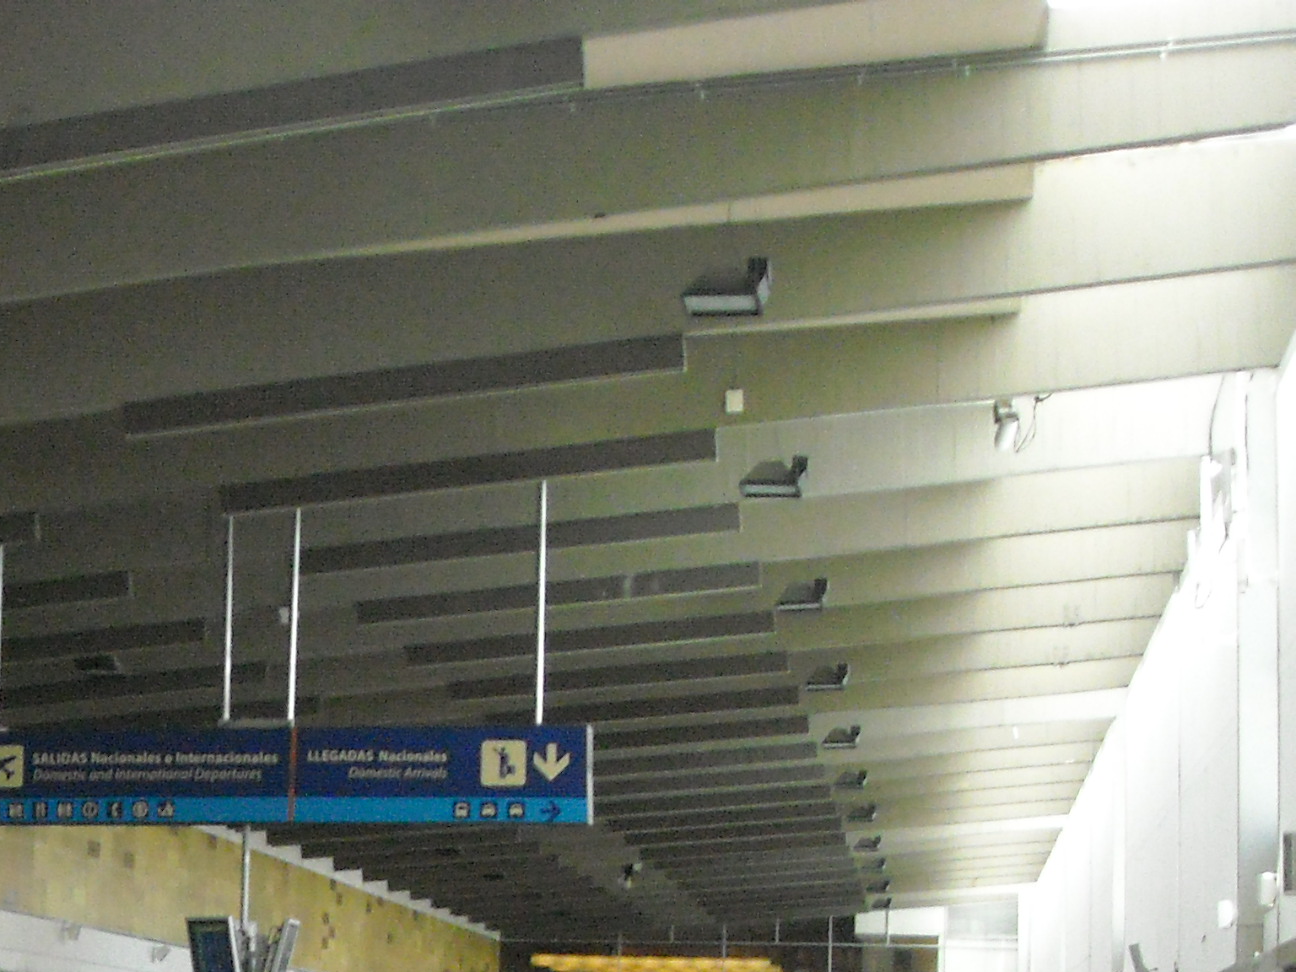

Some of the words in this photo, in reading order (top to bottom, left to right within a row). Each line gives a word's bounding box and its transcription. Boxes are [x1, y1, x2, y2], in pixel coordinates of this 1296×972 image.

[32, 751, 88, 765] SALIDAS
[90, 751, 161, 765] Nacionales
[175, 751, 279, 765] Internacionales
[307, 750, 374, 762] LLEGADAS
[378, 750, 448, 762] Nacionales
[404, 766, 448, 779] Arrivals
